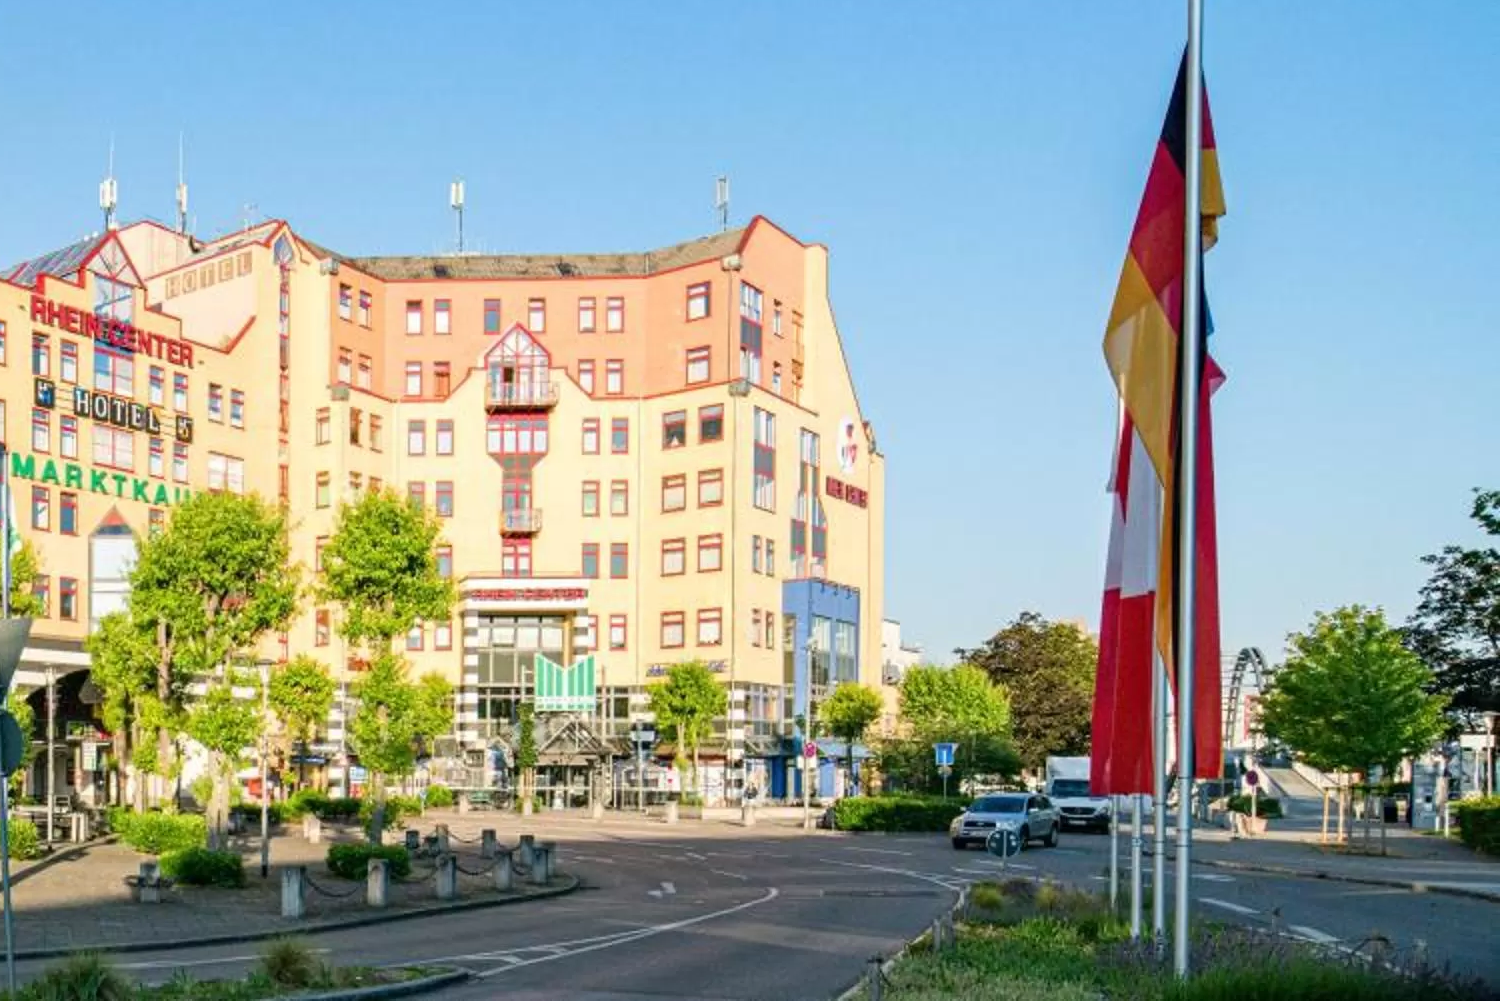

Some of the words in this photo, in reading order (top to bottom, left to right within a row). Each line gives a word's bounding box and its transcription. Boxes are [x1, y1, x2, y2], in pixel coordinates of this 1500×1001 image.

[31, 295, 104, 342] RHEIN
[106, 319, 194, 368] CENTER
[75, 387, 160, 434] HOTEL
[11, 452, 201, 506] MARKTKAU
